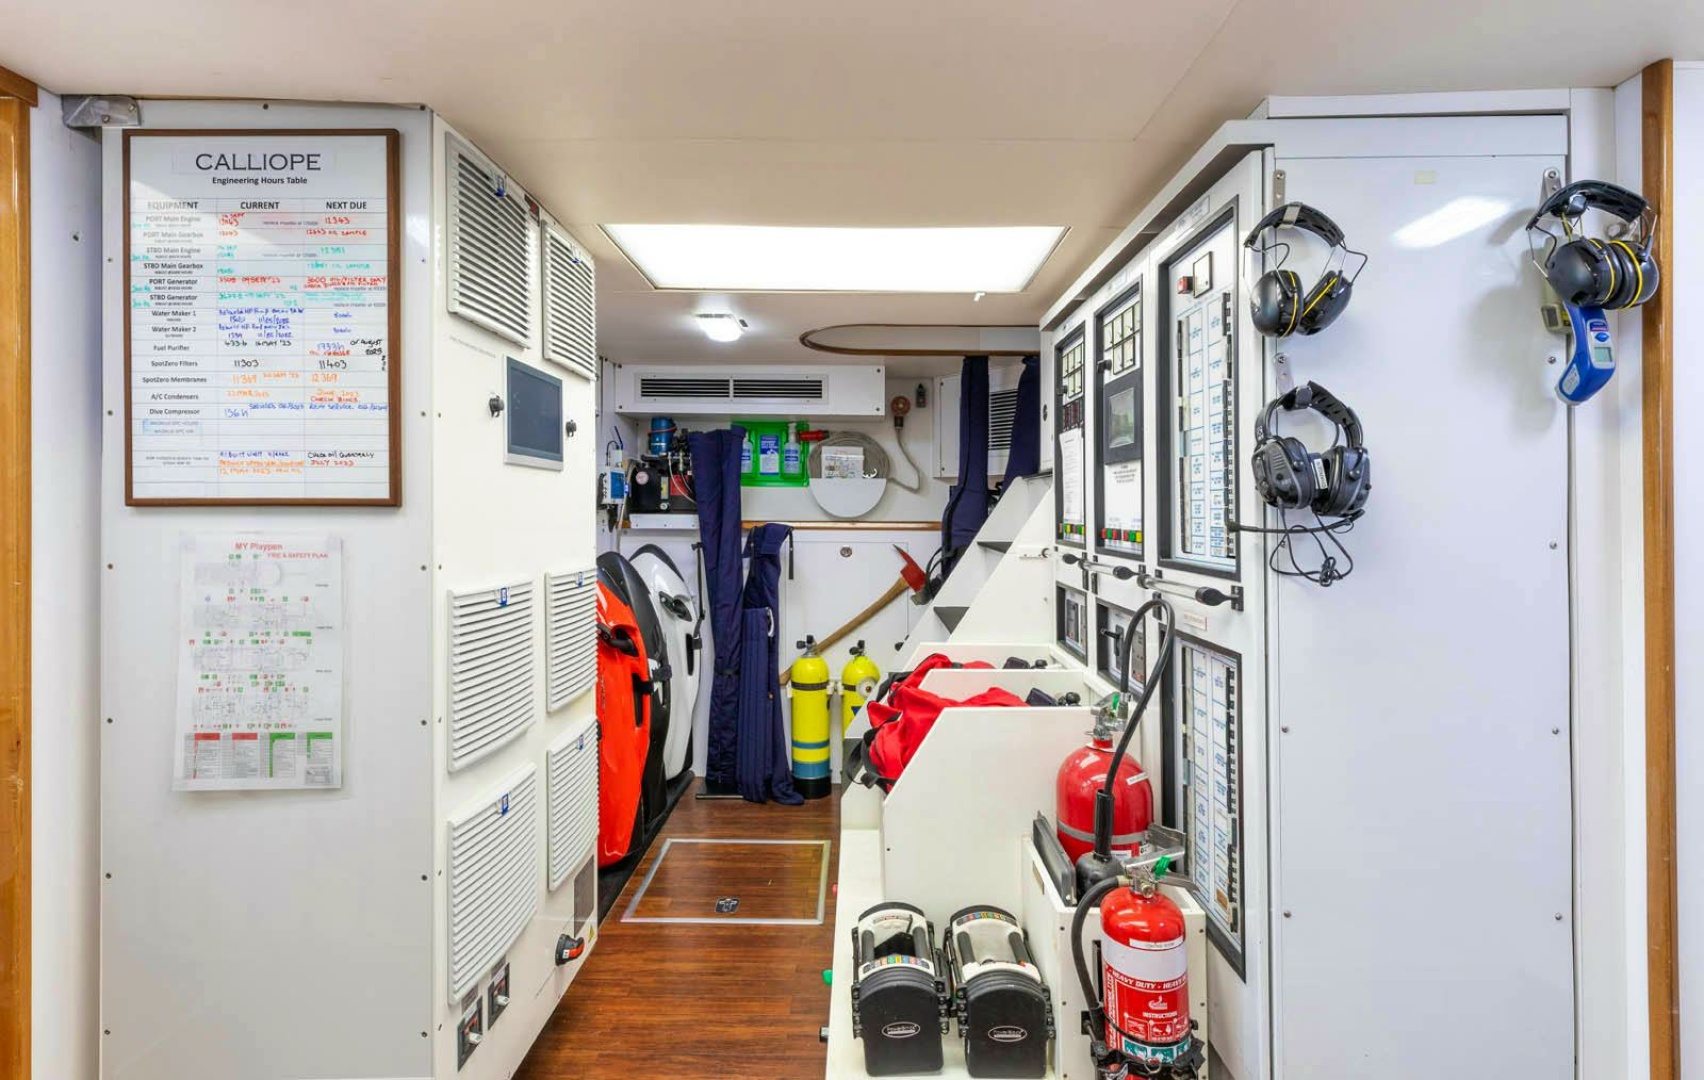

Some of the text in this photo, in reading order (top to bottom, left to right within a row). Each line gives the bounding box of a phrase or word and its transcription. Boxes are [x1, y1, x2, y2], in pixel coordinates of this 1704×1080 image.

[196, 154, 321, 171] CALLIOPE
[213, 177, 259, 186] Engineering
[148, 202, 199, 210] EQUIPMENT
[234, 359, 260, 367] 11303
[319, 360, 347, 370] 11403
[251, 543, 283, 552] Playpen
[1113, 970, 1135, 985] HEAVY
[1136, 981, 1157, 989] DUTY
